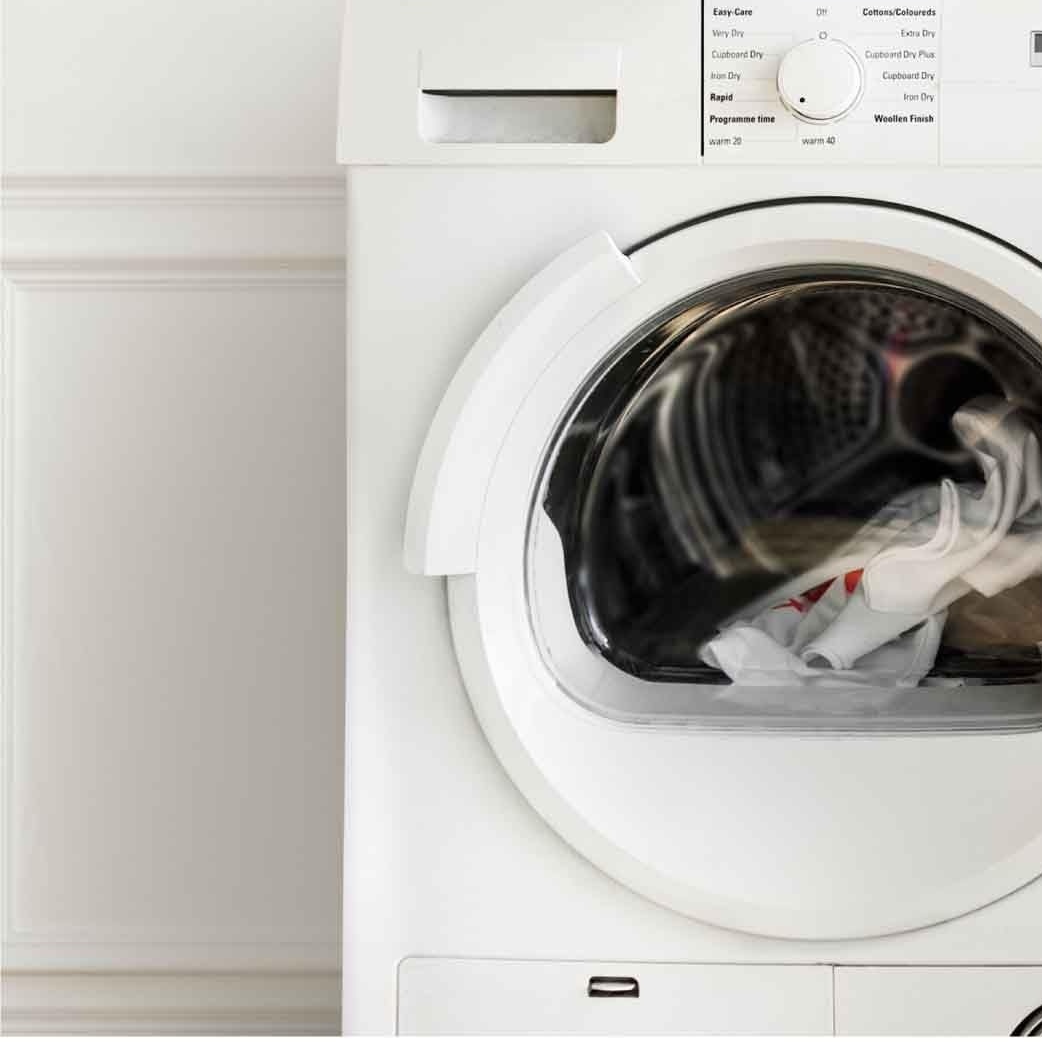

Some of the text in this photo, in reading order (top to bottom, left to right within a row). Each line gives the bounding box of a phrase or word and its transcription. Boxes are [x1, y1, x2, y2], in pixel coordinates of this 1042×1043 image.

[713, 8, 753, 17] Easy-Care
[863, 8, 936, 16] Cottons/Coloureds
[712, 30, 744, 38] Very Dry
[922, 30, 935, 38] Dry
[712, 51, 763, 59] Cupboard Dry
[865, 51, 904, 59] Cupboard
[905, 51, 918, 59] Dry
[728, 72, 741, 81] Dry
[882, 72, 935, 81] Cupboard Dry
[710, 93, 733, 102] Rapid
[904, 93, 934, 102] Iron Dry
[710, 115, 775, 124] Programme time
[874, 115, 934, 123] Woollen Finish
[826, 137, 836, 145] 40
